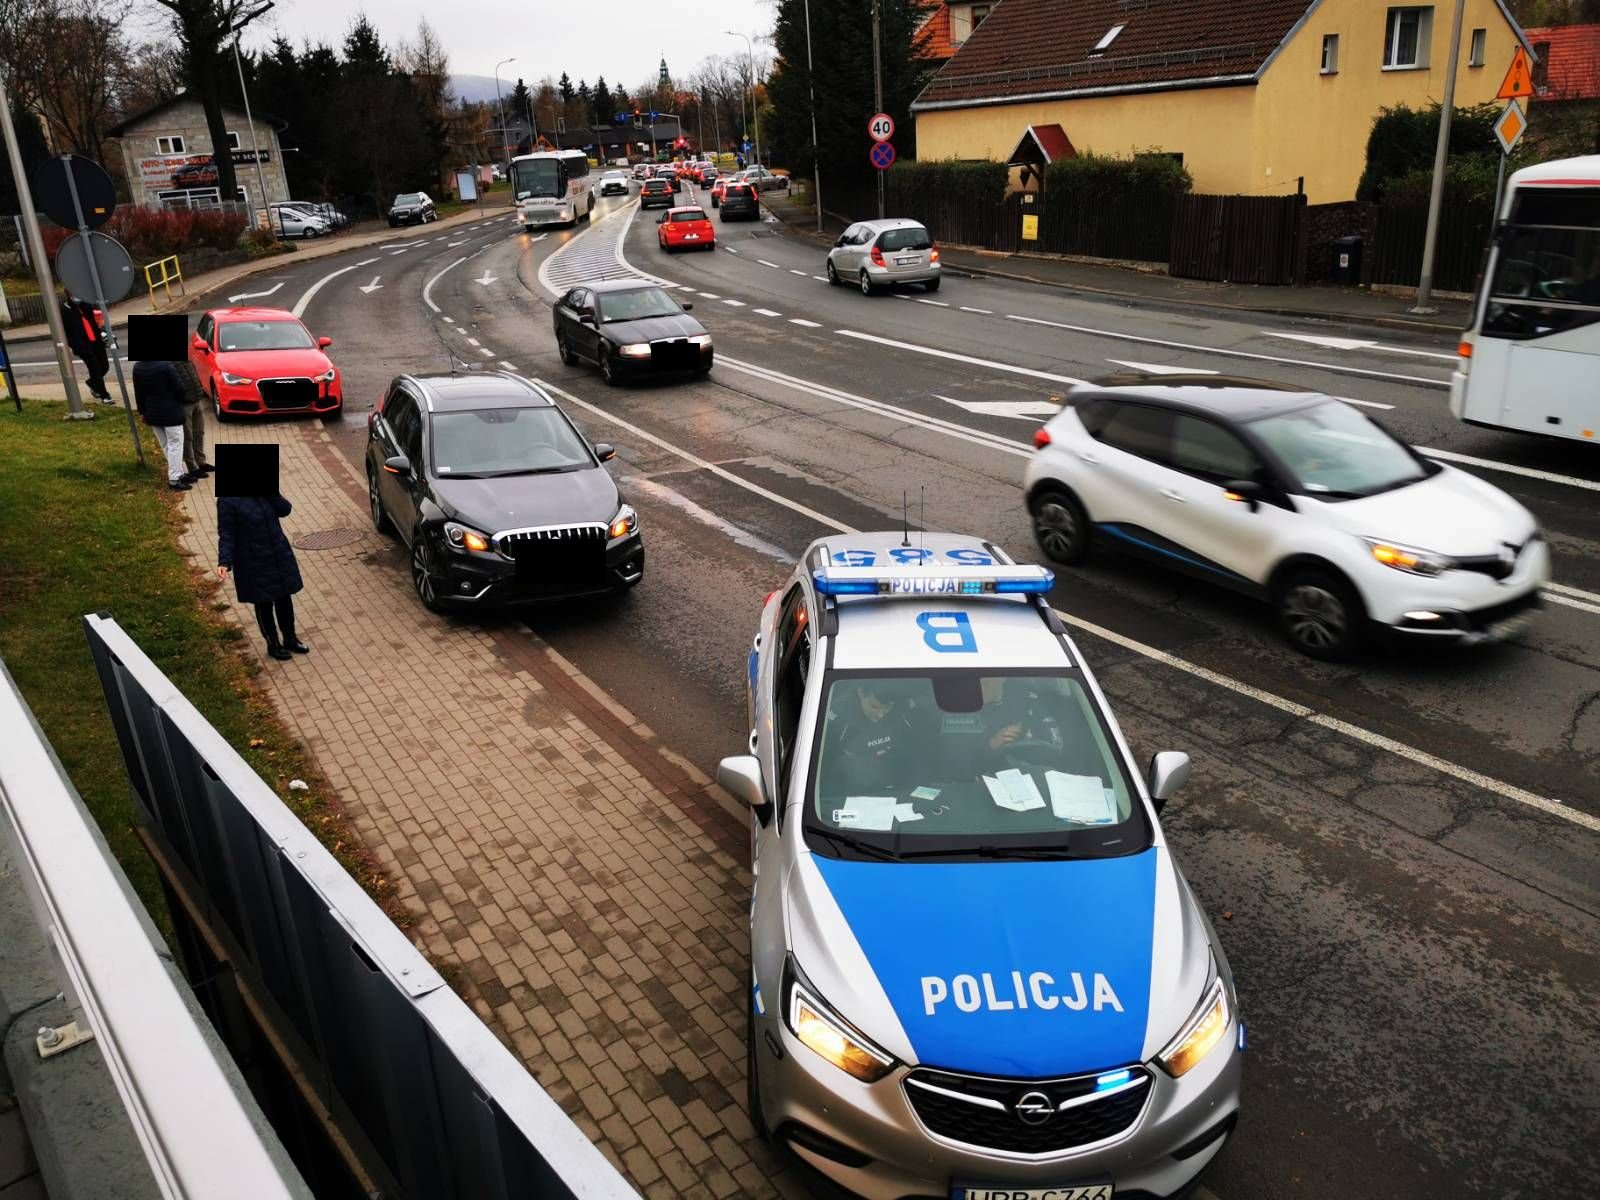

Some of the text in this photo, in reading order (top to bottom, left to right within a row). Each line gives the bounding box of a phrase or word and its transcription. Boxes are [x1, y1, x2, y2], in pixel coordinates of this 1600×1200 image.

[872, 121, 891, 135] 40
[242, 152, 269, 160] SERIS
[892, 577, 957, 593] POLICJA
[916, 611, 979, 653] B
[920, 971, 1125, 1016] POLICJA
